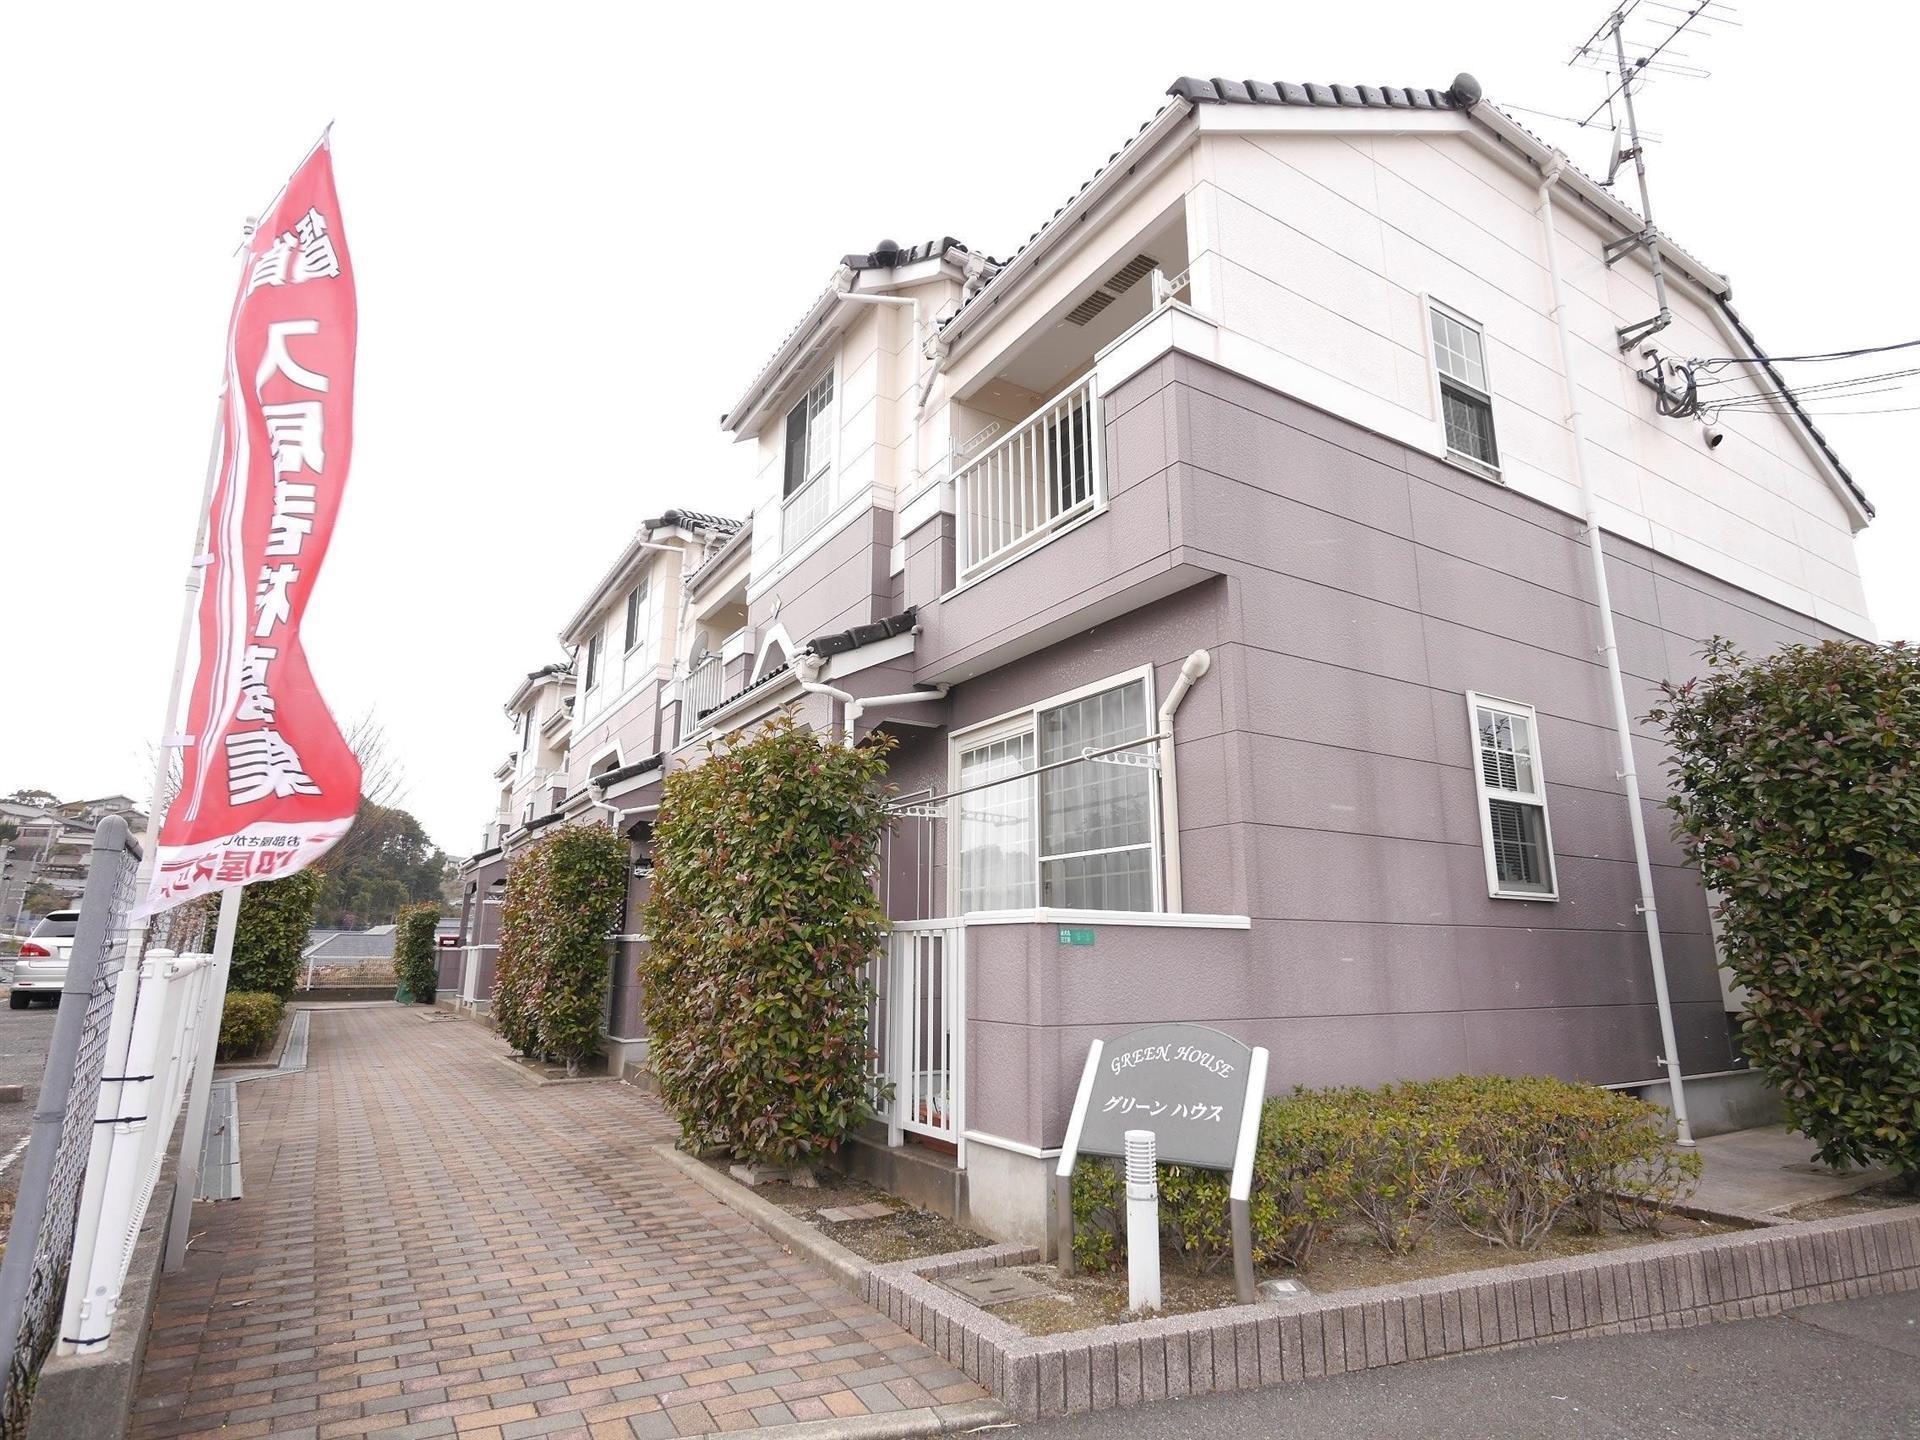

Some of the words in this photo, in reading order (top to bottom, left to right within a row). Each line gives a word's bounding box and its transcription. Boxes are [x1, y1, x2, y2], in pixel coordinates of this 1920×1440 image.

[1111, 1043, 1172, 1076] GREEN
[1173, 1045, 1235, 1079] HOUSE
[1102, 1095, 1168, 1117] グリーン
[1170, 1102, 1224, 1122] ハウス
